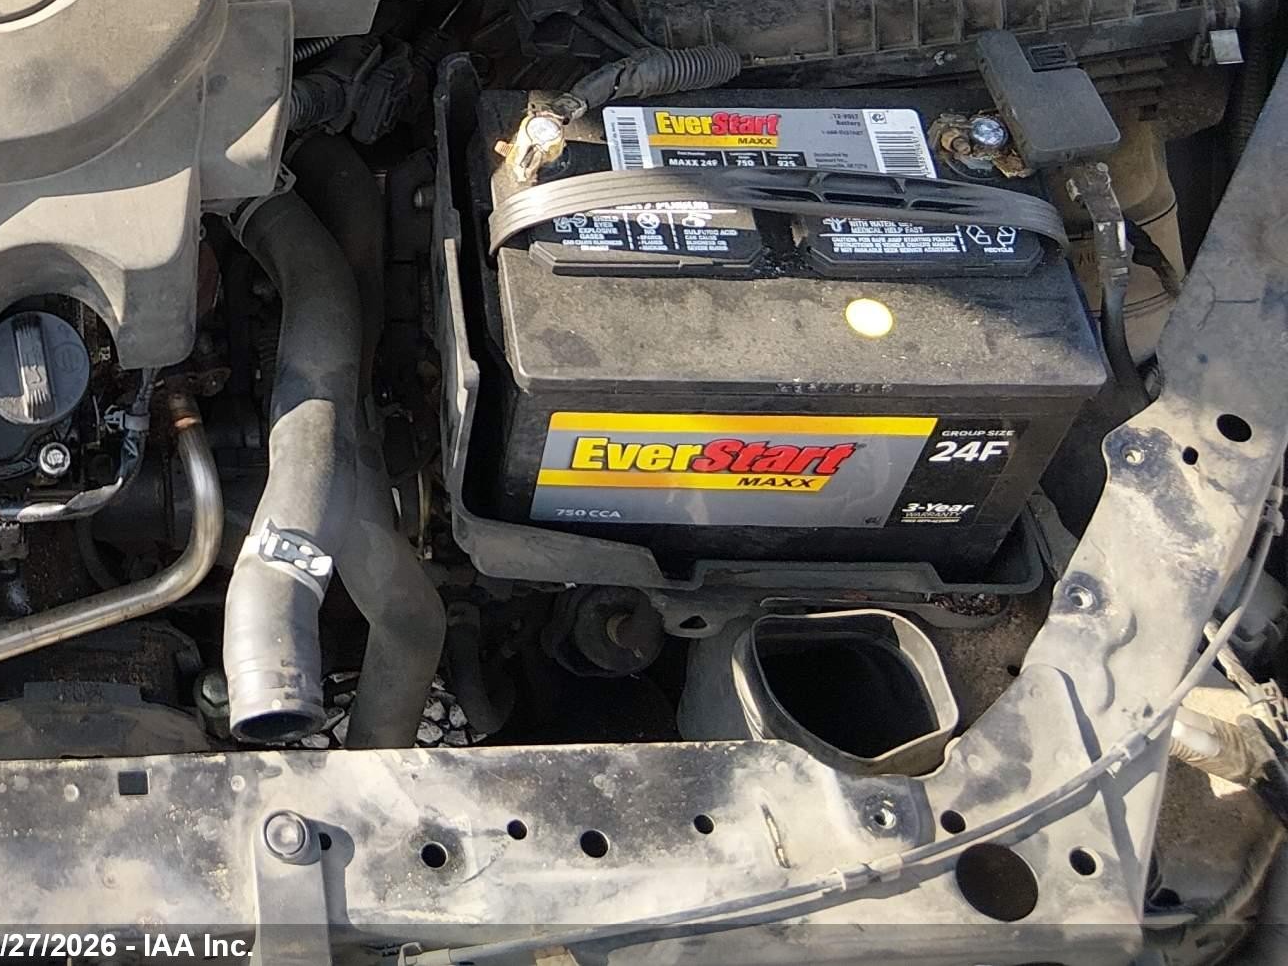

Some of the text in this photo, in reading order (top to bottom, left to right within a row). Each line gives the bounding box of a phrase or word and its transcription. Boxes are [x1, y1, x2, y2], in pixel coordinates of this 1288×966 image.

[654, 111, 779, 136] EverStart
[737, 137, 773, 146] MAXX
[668, 158, 699, 166] MAXX
[736, 159, 755, 167] 750
[570, 436, 857, 475] EverStart
[928, 441, 1009, 462] 24F
[736, 476, 816, 489] MAXX
[902, 502, 975, 512] 3-Year
[555, 509, 621, 518] 750 CCA
